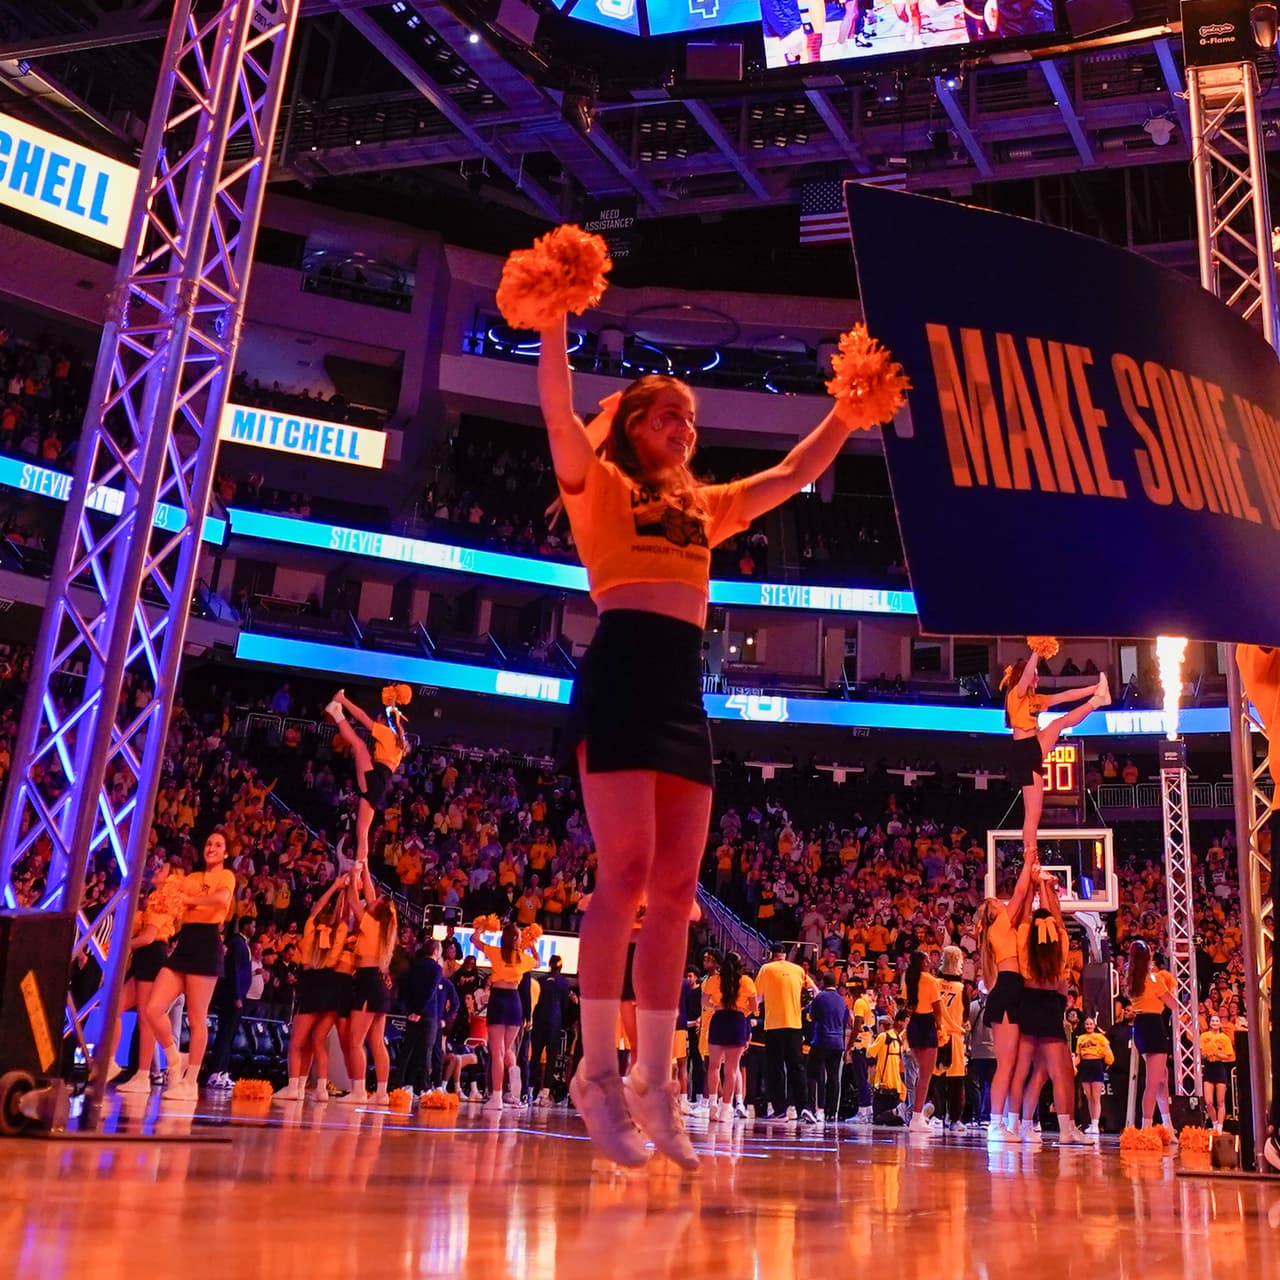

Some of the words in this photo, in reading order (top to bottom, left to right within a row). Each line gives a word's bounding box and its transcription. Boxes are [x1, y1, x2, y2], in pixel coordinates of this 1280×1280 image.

[231, 410, 360, 461] MITCHELL
[925, 322, 1128, 500] MAKE
[1111, 352, 1263, 524] SOME
[329, 526, 382, 554] STEVIE
[760, 584, 810, 608] STEVIE
